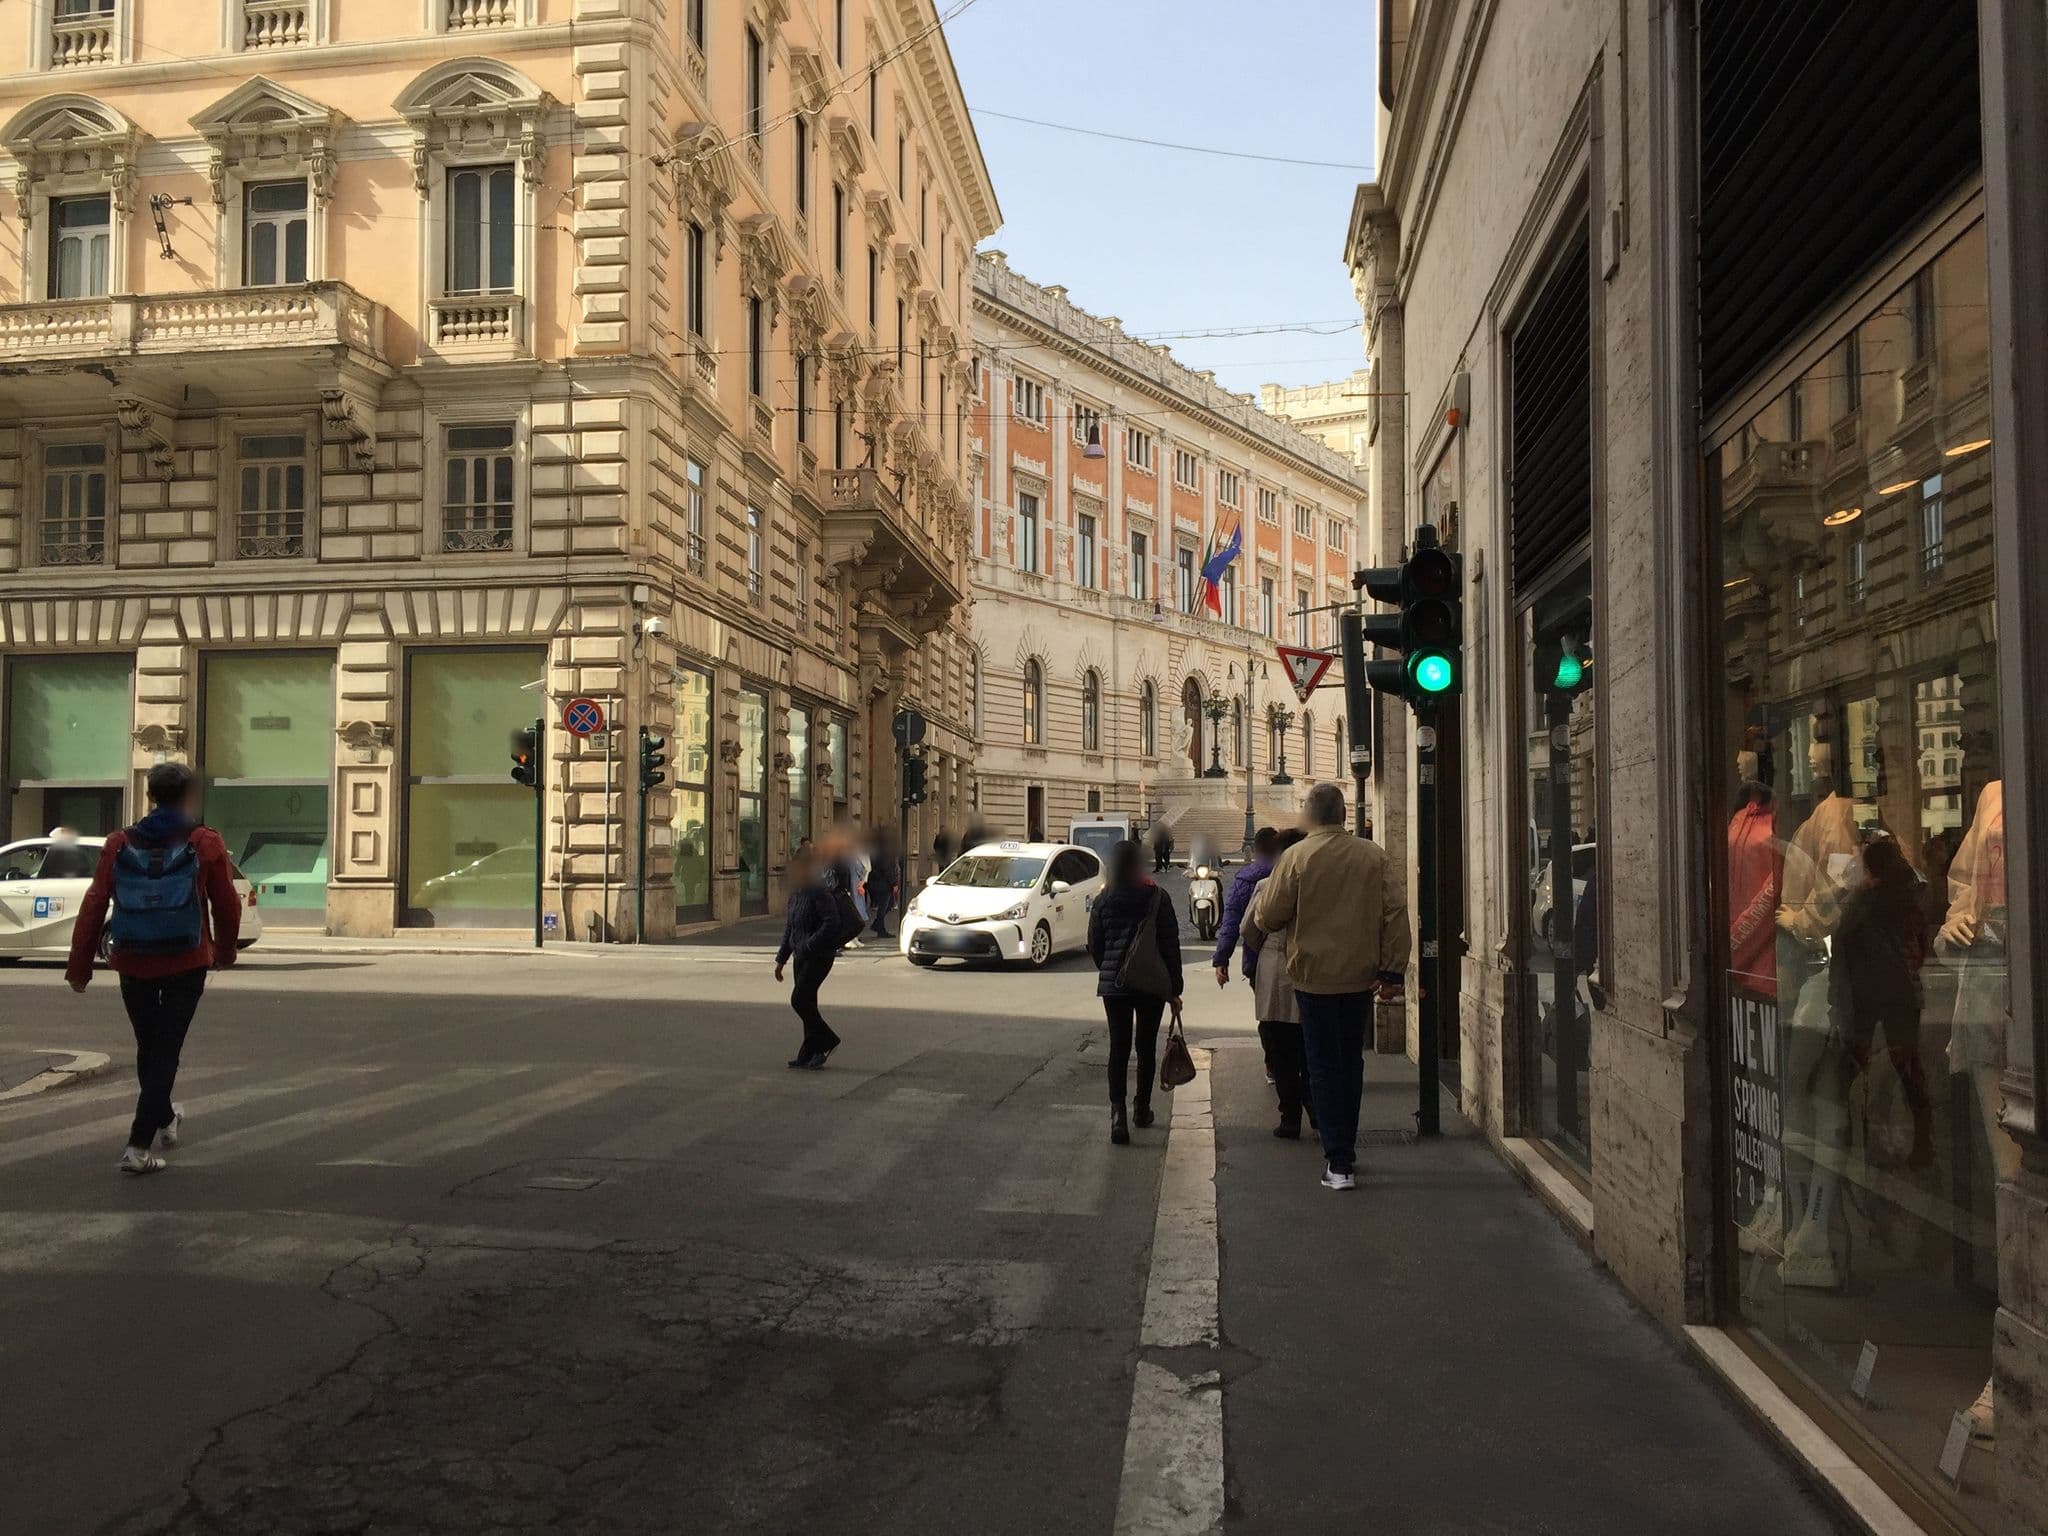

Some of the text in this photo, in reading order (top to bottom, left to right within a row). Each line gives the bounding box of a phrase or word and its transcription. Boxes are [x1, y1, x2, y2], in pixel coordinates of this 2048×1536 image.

[1732, 996, 1776, 1077] NEW
[1734, 1075, 1780, 1140] SPRING
[1735, 1128, 1781, 1182] COLLECTION
